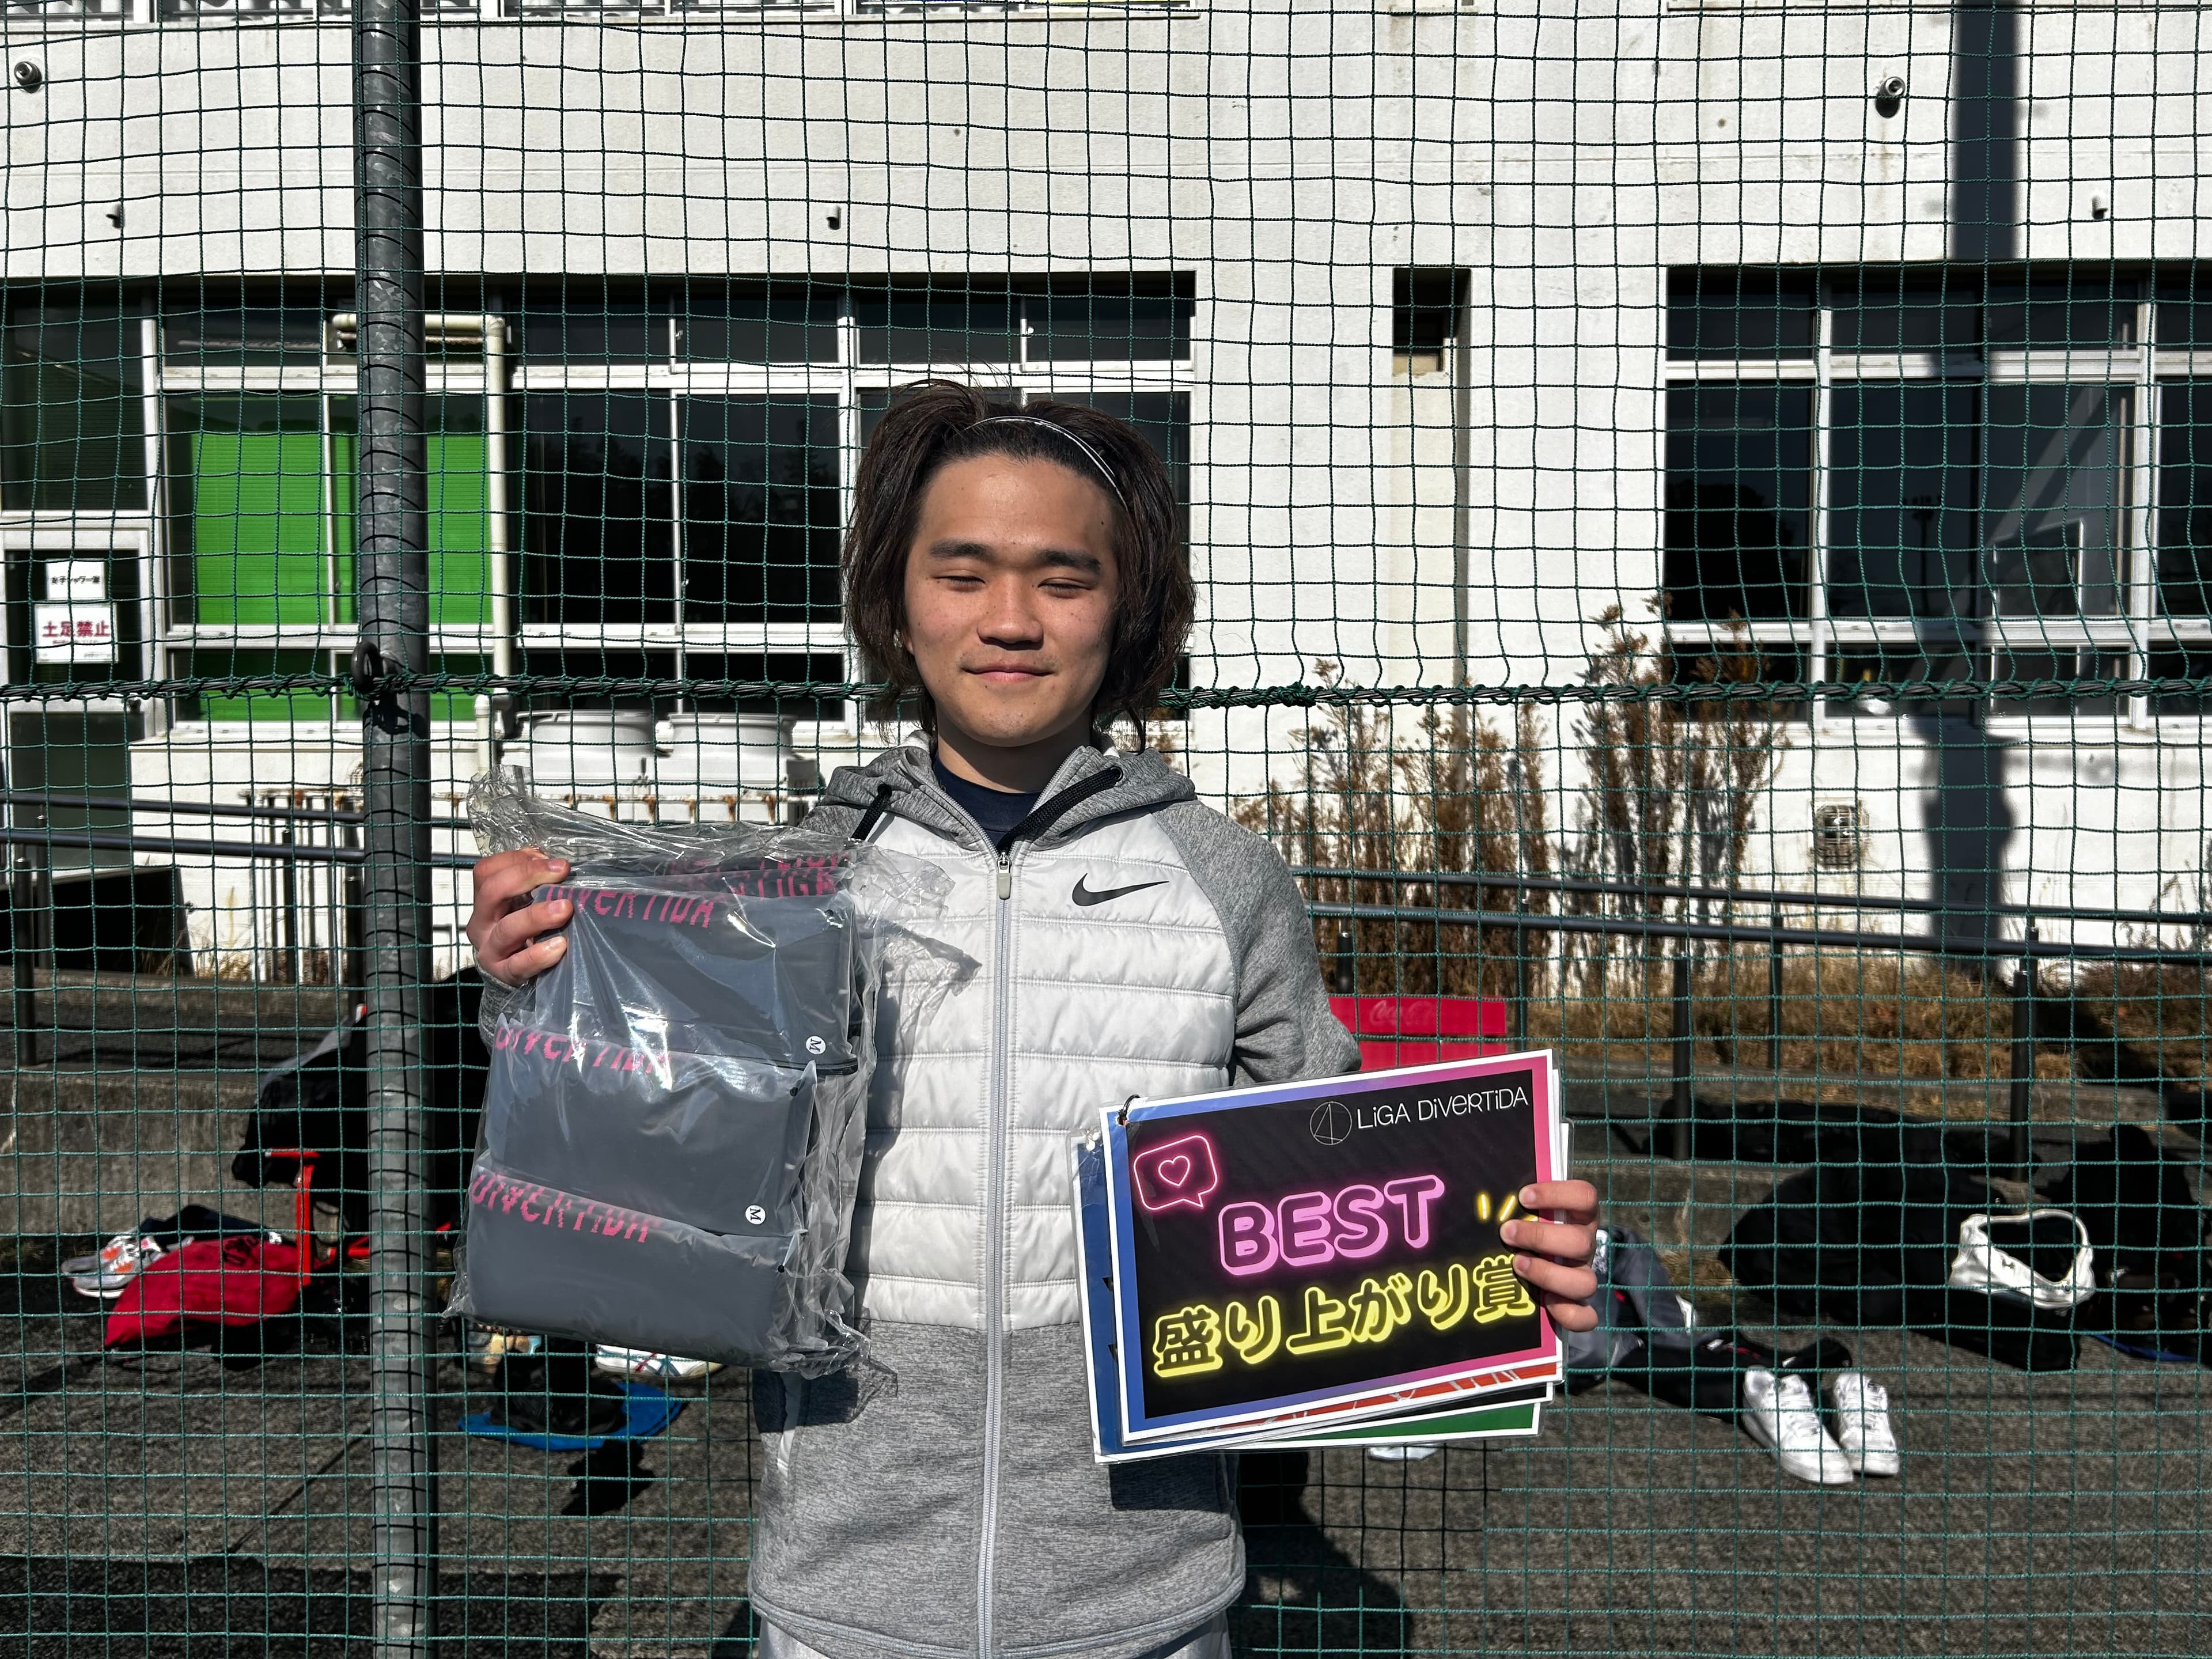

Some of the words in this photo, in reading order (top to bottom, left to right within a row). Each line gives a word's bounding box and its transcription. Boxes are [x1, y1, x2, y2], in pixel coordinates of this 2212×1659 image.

[42, 620, 111, 637] 土足禁止
[809, 1038, 823, 1053] M
[749, 1207, 762, 1222] M
[1218, 1174, 1445, 1276] BEST
[1153, 1253, 1535, 1377] 盛り上がり賞
